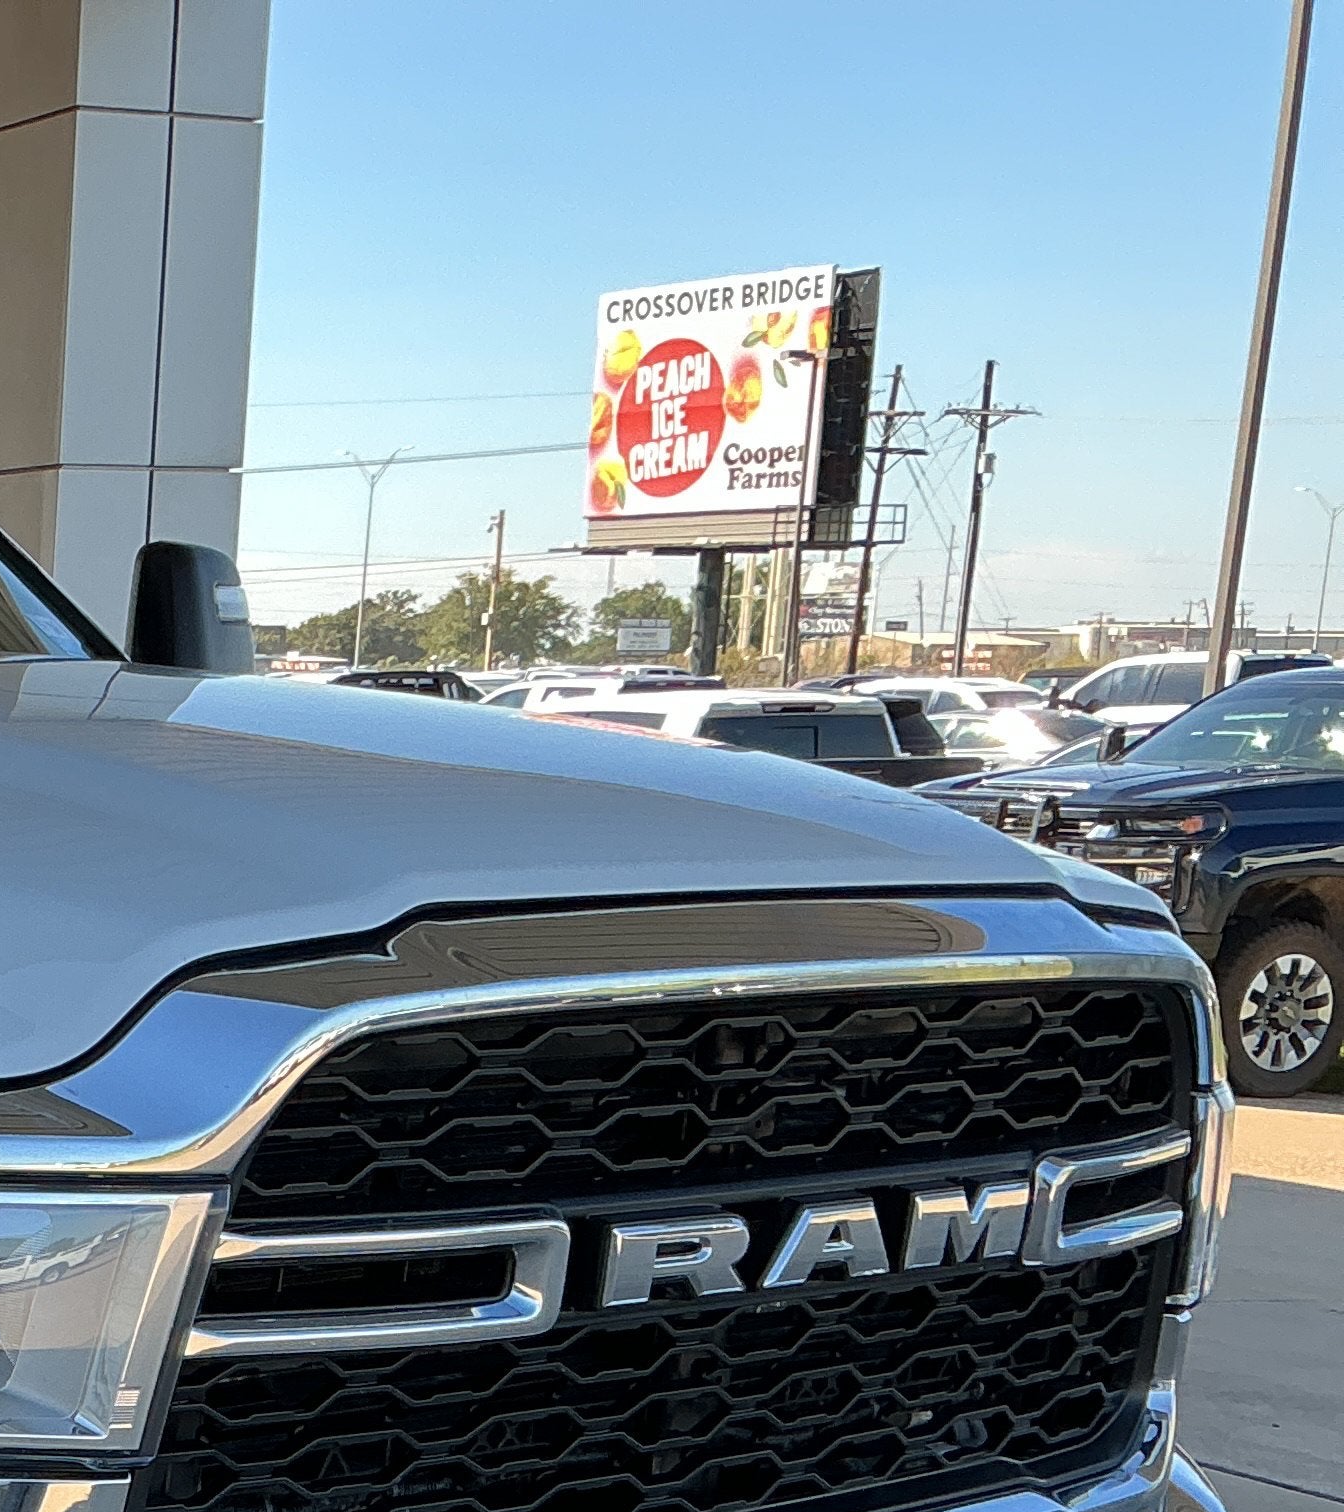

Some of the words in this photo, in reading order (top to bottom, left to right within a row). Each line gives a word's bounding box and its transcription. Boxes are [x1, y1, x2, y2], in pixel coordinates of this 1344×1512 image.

[606, 286, 733, 324] CROSSOVER
[742, 274, 826, 309] BRIDGE
[635, 351, 711, 405] PEACH
[651, 396, 688, 439] ICE
[628, 431, 709, 483] CREAM
[723, 443, 806, 469] Cooper
[727, 467, 803, 490] Farms
[602, 1181, 1029, 1307] RAM
